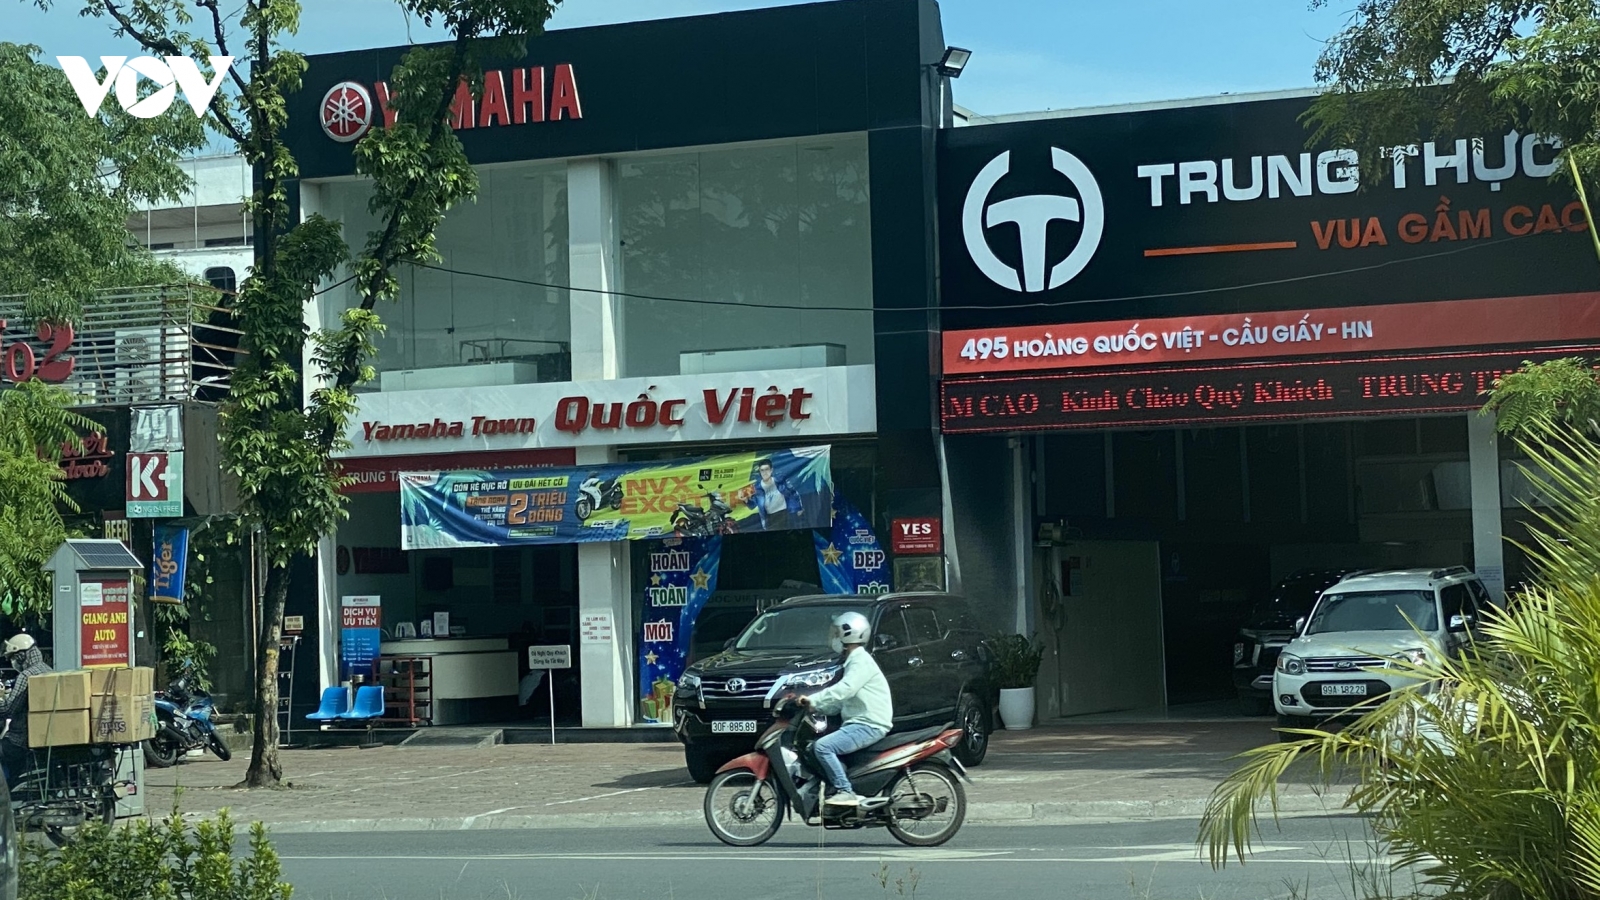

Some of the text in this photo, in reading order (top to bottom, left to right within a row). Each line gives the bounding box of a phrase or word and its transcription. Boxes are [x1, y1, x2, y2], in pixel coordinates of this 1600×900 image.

[374, 64, 582, 130] YMAHA
[1137, 129, 1564, 207] TRUNG THỰC
[1311, 195, 1590, 250] VUA GẦM CAO
[961, 337, 1007, 360] 495
[1014, 330, 1087, 358] HOÀNG
[1094, 323, 1157, 354] QUỐC
[1162, 325, 1204, 354] VIỆT
[1222, 316, 1268, 346] CẦU
[1274, 313, 1324, 343] GIẤY
[1342, 320, 1373, 340] HN
[979, 393, 1039, 416] CAO
[1358, 371, 1463, 399] TRUNG
[136, 409, 179, 440] 491
[362, 385, 812, 442] Yamaha Town Quốc Việt
[131, 456, 177, 498] K+
[346, 471, 386, 483] TRUNG
[626, 475, 694, 496] NVX
[508, 493, 528, 525] 2
[530, 489, 567, 507] TRIỆU
[620, 489, 742, 515] EXCIT
[528, 506, 563, 523] ĐỒNG
[105, 519, 128, 541] BEER
[901, 523, 931, 535] YES
[155, 541, 178, 591] Tiger
[651, 549, 689, 572] HOÀN
[853, 550, 885, 572] ĐẸP
[650, 583, 687, 607] TOÀN
[82, 612, 127, 624] GIANG ANH
[343, 607, 377, 618] DỊCH VỤ
[357, 616, 377, 626] TIÊN
[94, 629, 116, 641] AUTO
[644, 618, 673, 642] MỚI
[713, 722, 755, 732] 30F-885.89
